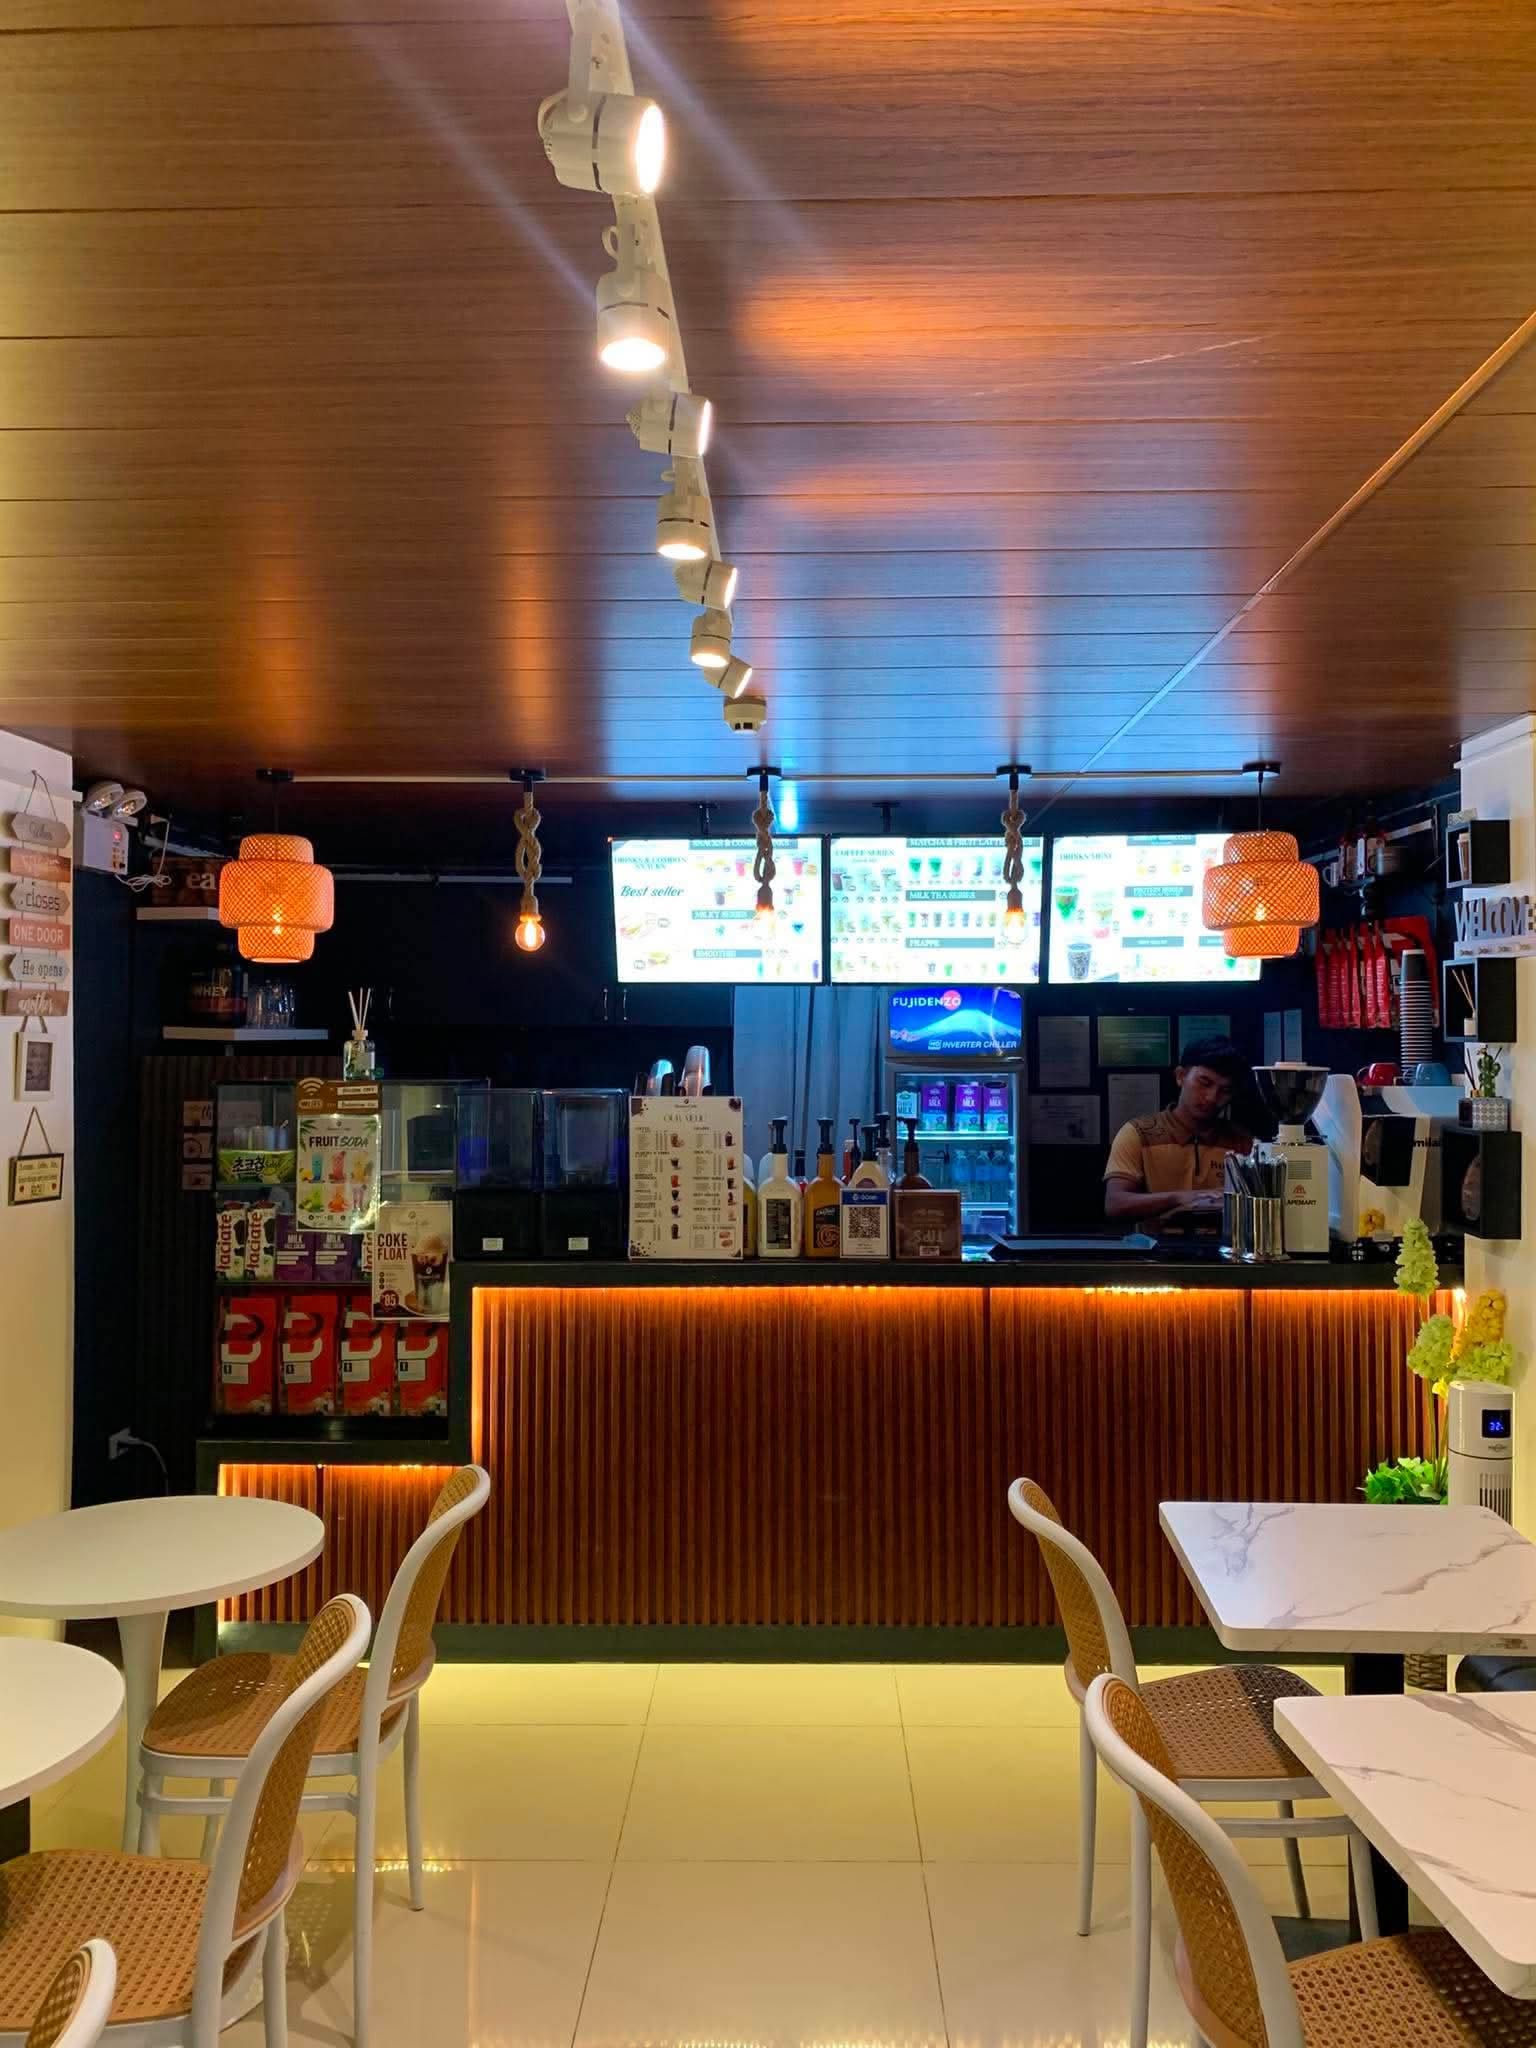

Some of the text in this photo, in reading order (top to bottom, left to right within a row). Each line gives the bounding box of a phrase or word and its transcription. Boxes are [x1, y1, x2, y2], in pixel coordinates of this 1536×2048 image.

[620, 886, 685, 897] Best seller
[14, 924, 64, 944] ONE DOOR
[22, 960, 63, 980] He opens
[892, 996, 961, 1008] FUJIDENZO
[942, 1041, 982, 1049] INVERTER
[983, 1041, 1017, 1049] CHILLER
[309, 1136, 369, 1147] FRUIT SODA
[377, 1233, 408, 1247] COKE
[377, 1247, 408, 1261] FLOAT
